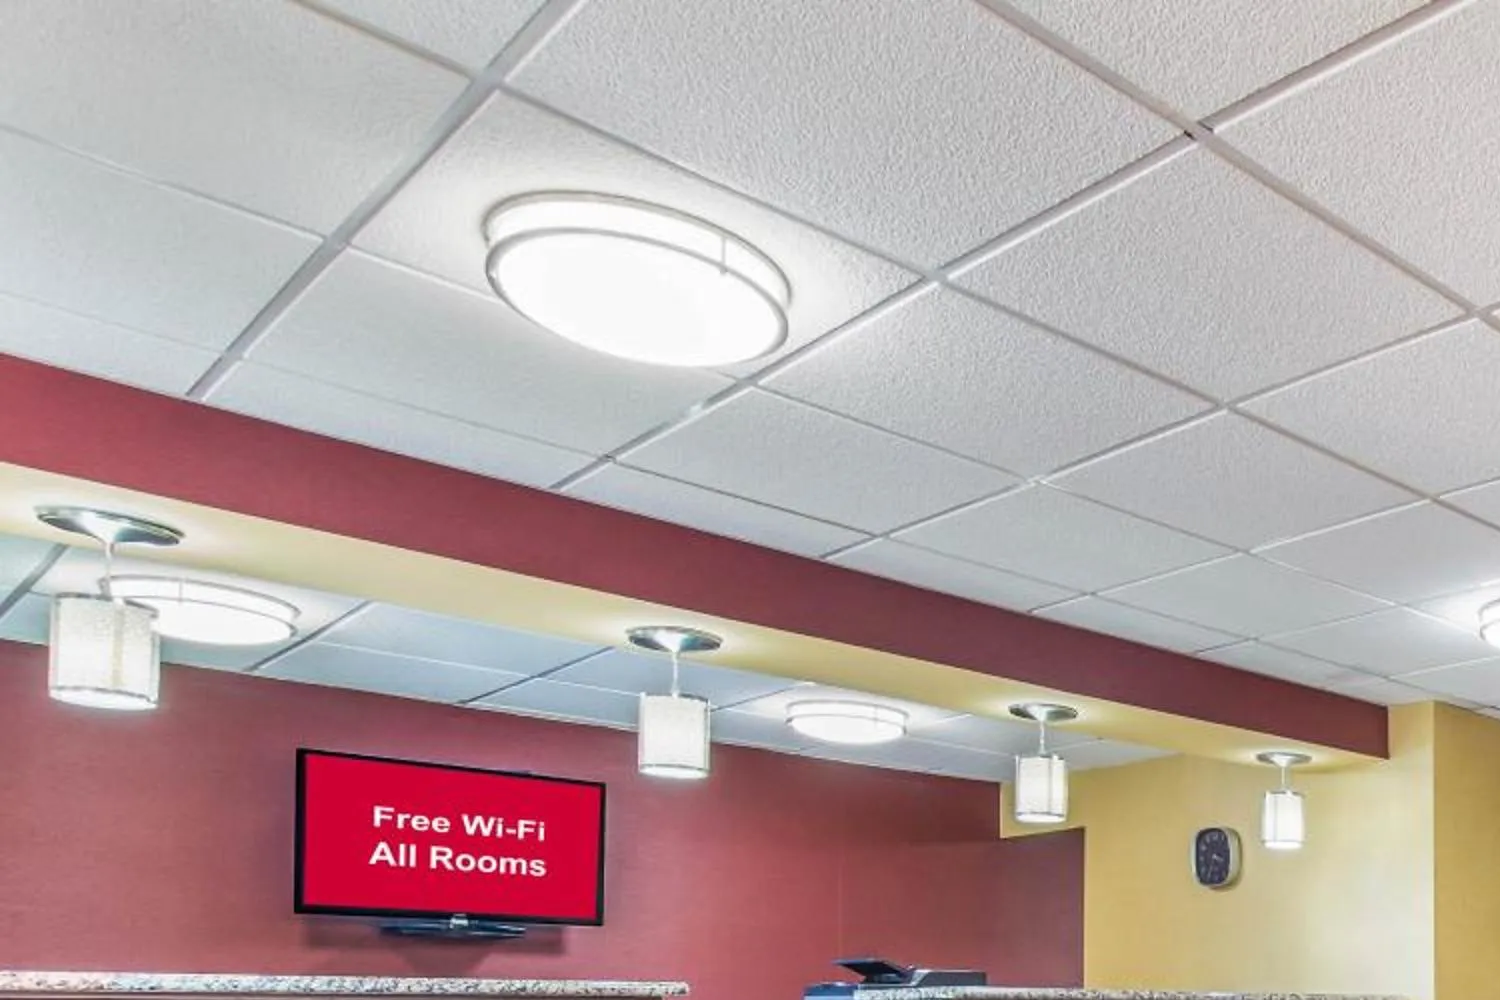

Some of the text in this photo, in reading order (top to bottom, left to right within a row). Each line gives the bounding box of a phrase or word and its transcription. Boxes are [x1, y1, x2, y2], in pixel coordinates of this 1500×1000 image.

[373, 805, 546, 842] Free Wi-Fi
[369, 841, 547, 878] All Rooms
